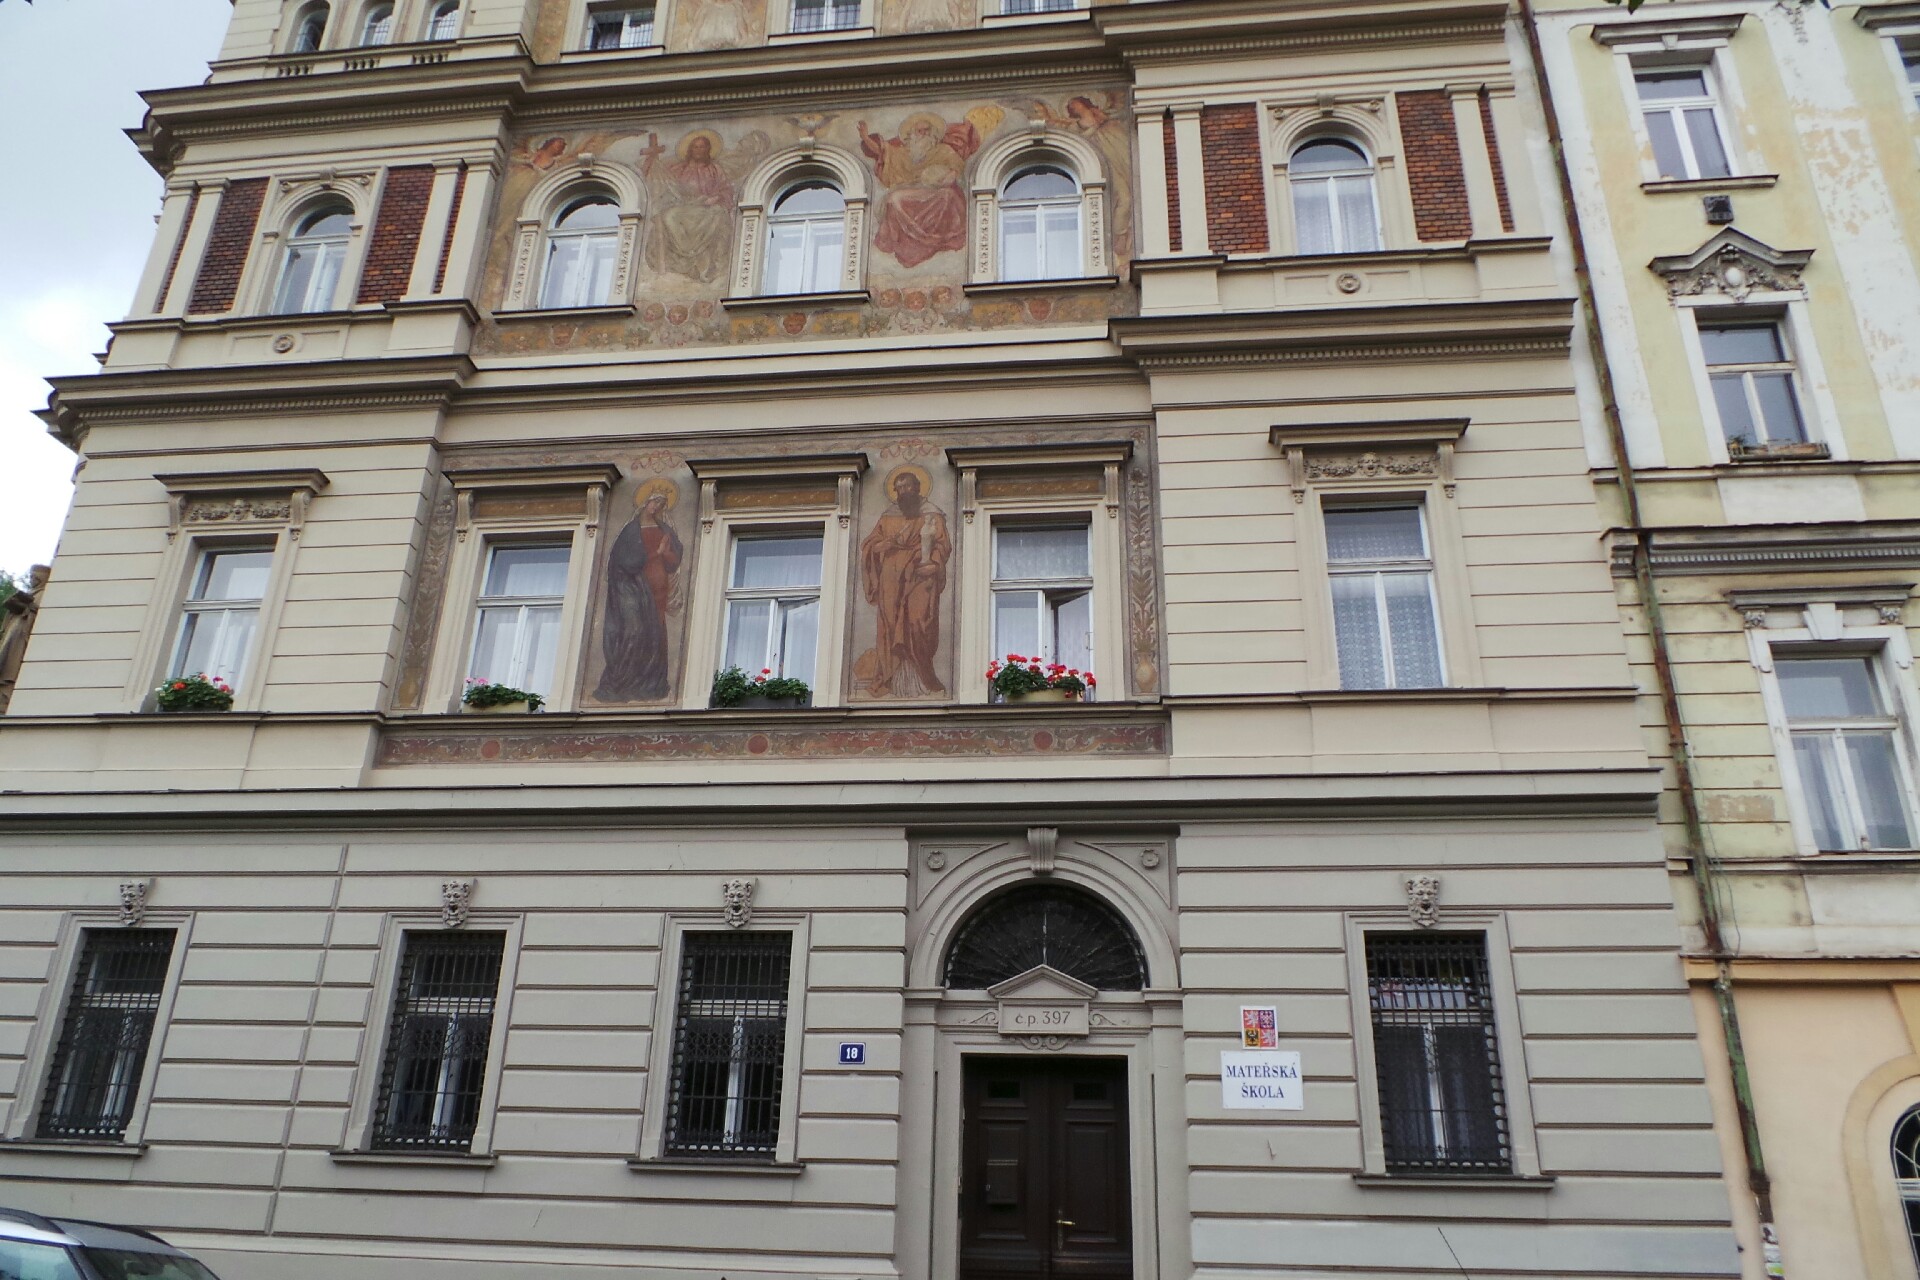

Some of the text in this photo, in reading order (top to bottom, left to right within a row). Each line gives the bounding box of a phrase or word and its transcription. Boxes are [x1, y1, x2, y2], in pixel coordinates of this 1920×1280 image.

[1042, 1010, 1071, 1024] 397
[846, 1047, 858, 1059] 18
[1225, 1062, 1298, 1078] MATEŘSKÁ
[1241, 1082, 1285, 1098] ŠKOLA
